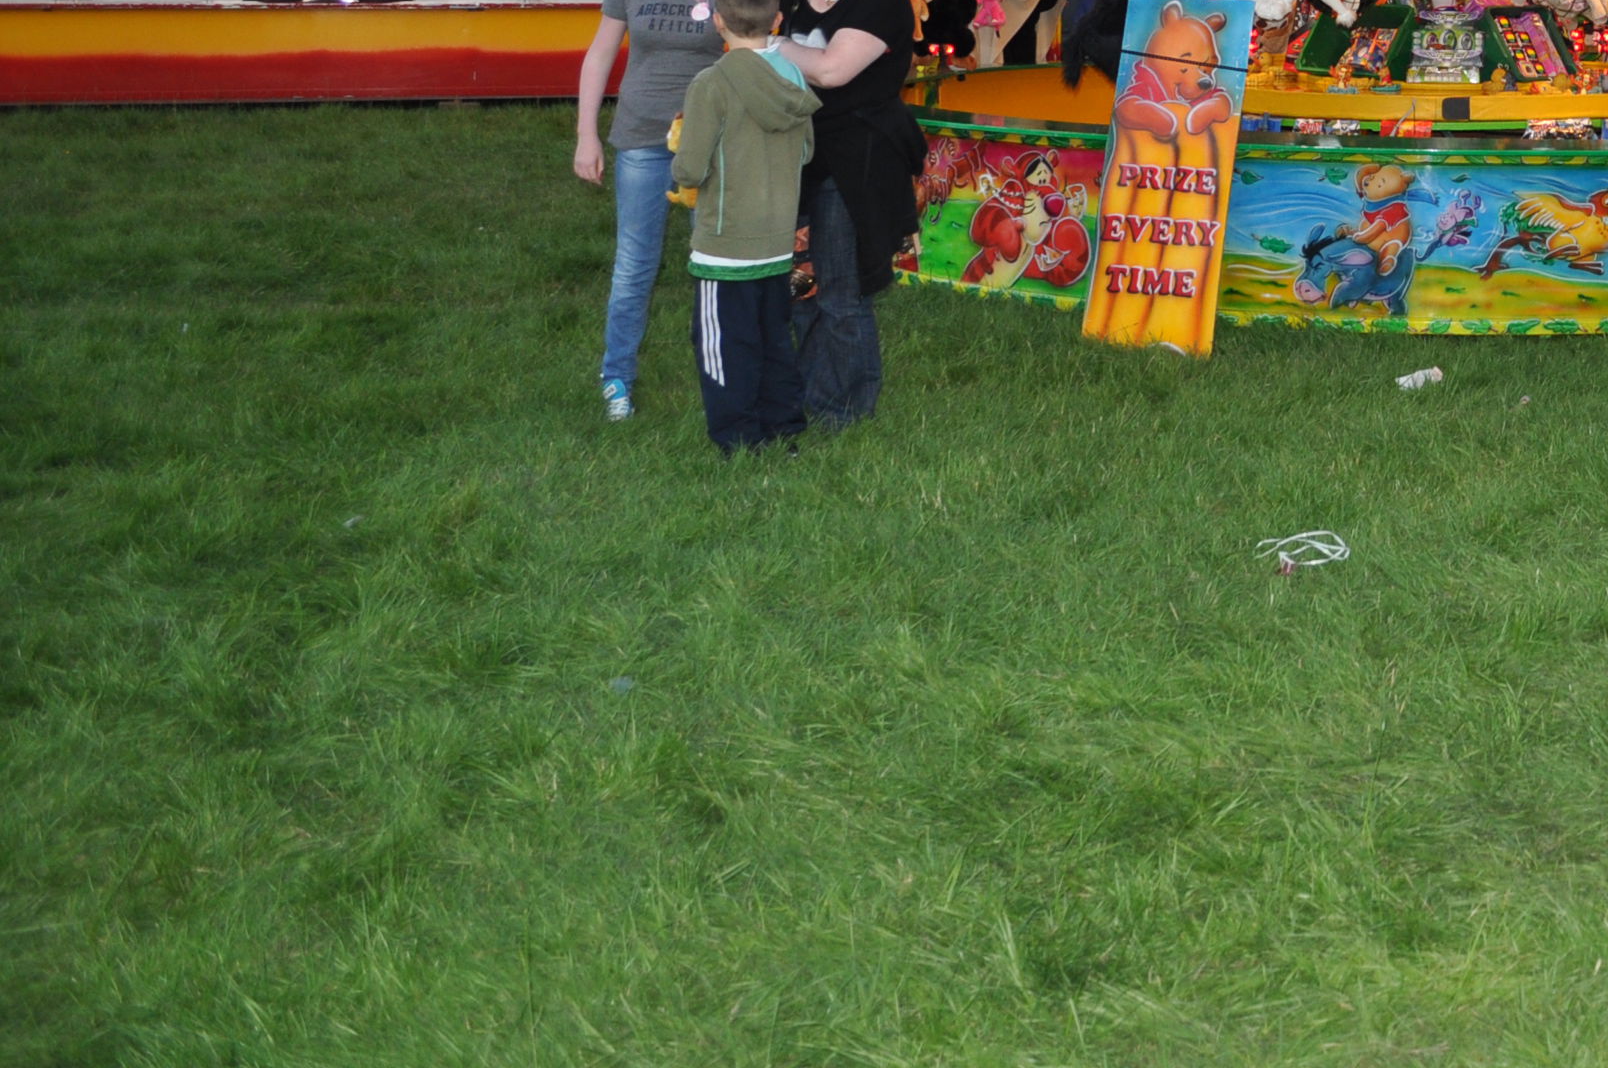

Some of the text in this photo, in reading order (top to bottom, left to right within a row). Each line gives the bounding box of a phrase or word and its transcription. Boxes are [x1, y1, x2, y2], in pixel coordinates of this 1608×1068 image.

[636, 1, 713, 18] ABERCRO
[648, 18, 705, 34] & FITCH
[1118, 164, 1217, 195] PRIZE
[1101, 213, 1221, 247] EVERY
[1106, 264, 1197, 298] TIME
